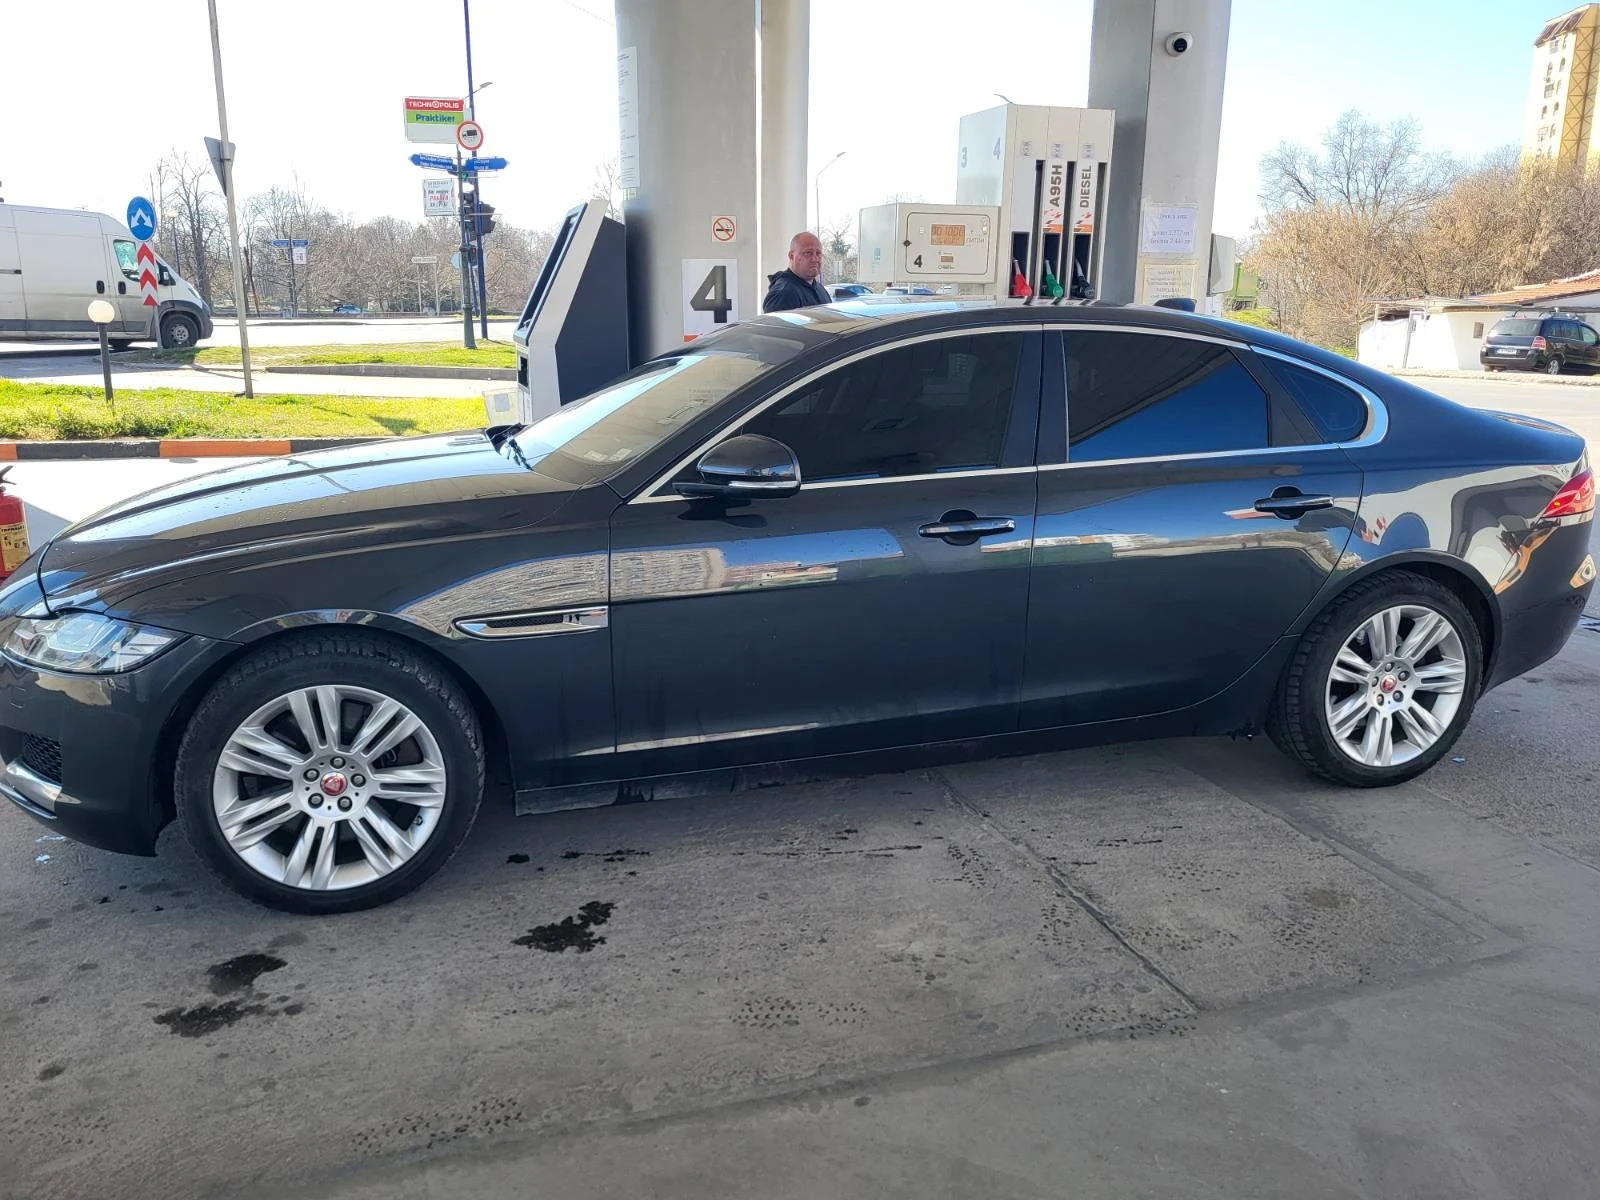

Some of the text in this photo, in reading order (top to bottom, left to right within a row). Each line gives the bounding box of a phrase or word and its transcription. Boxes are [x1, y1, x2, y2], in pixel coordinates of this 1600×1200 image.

[408, 100, 459, 109] TECHNOPOLIS
[415, 113, 455, 122] Praktiker
[961, 146, 967, 168] 3
[992, 137, 1001, 160] 4
[1049, 164, 1063, 208] A95H
[1079, 165, 1092, 208] DIESEL
[914, 254, 923, 268] 4
[689, 265, 732, 323] 4
